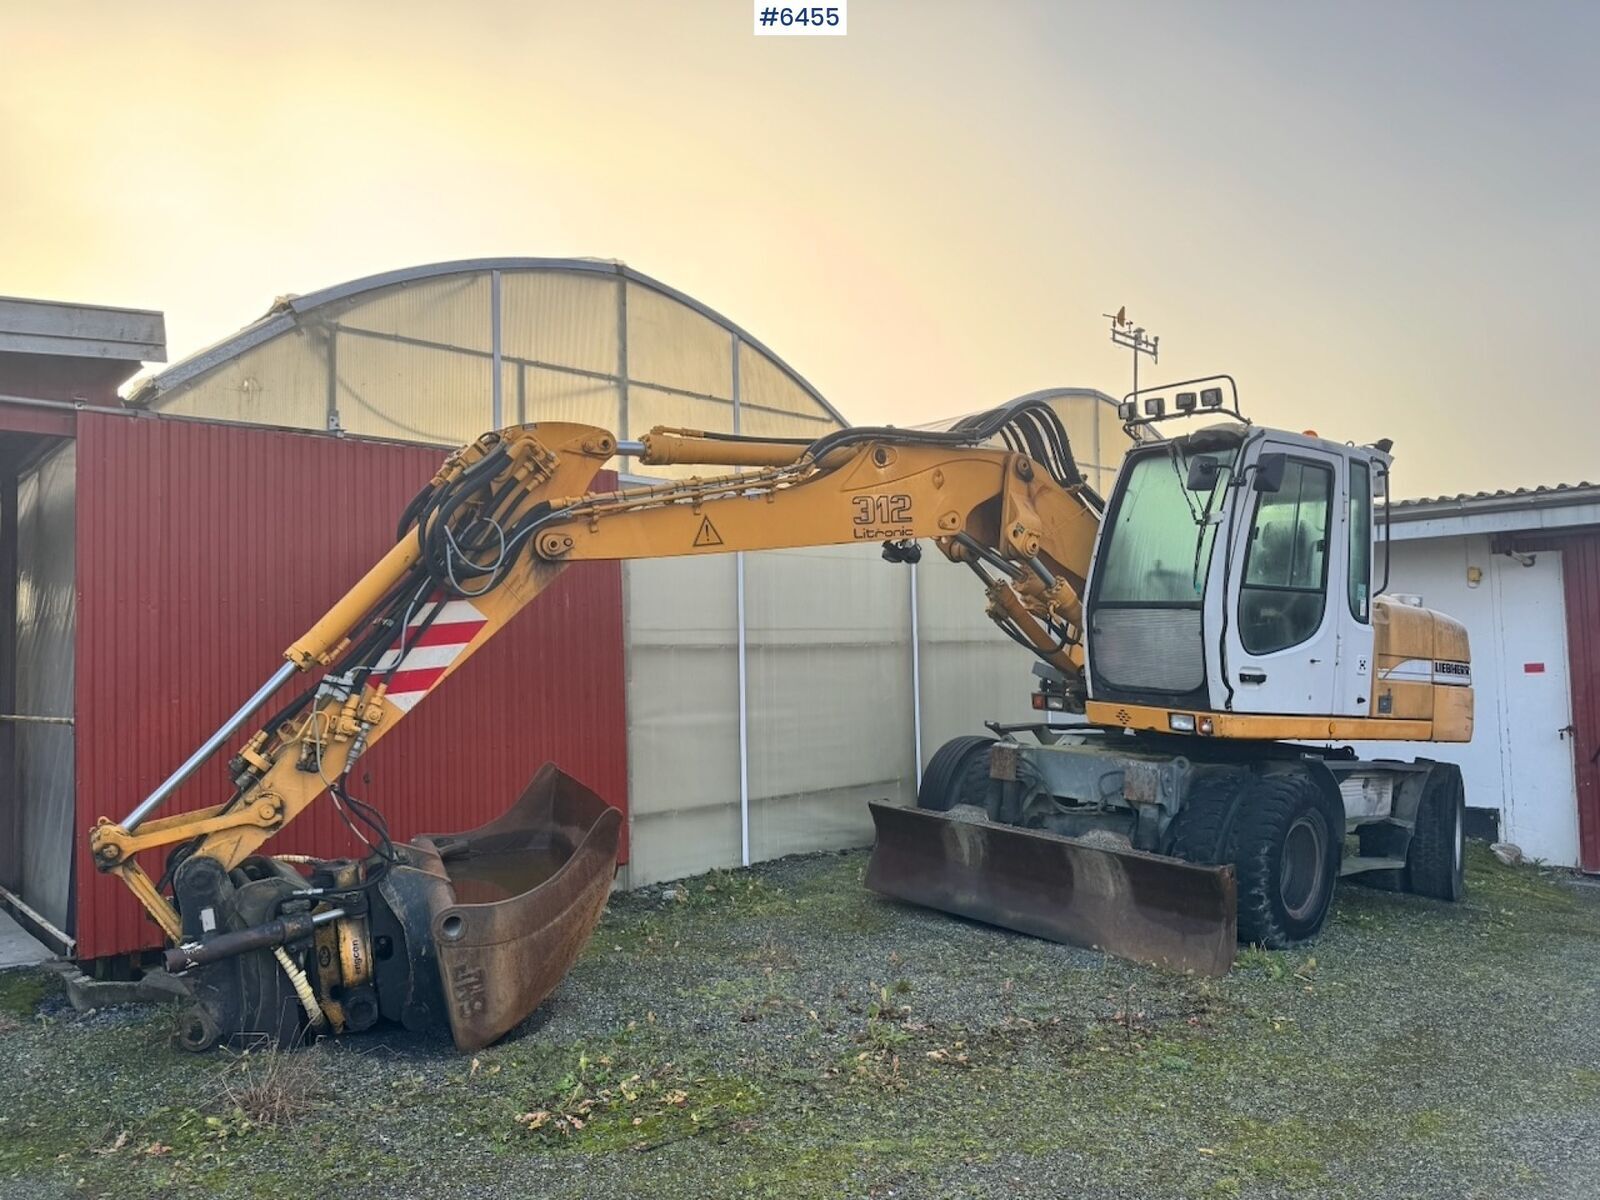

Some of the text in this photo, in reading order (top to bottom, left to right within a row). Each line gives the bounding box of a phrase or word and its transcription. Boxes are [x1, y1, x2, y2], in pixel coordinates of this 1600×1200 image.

[852, 494, 913, 524] 312
[853, 526, 914, 539] Litronic
[1434, 661, 1470, 675] LIEBHERR
